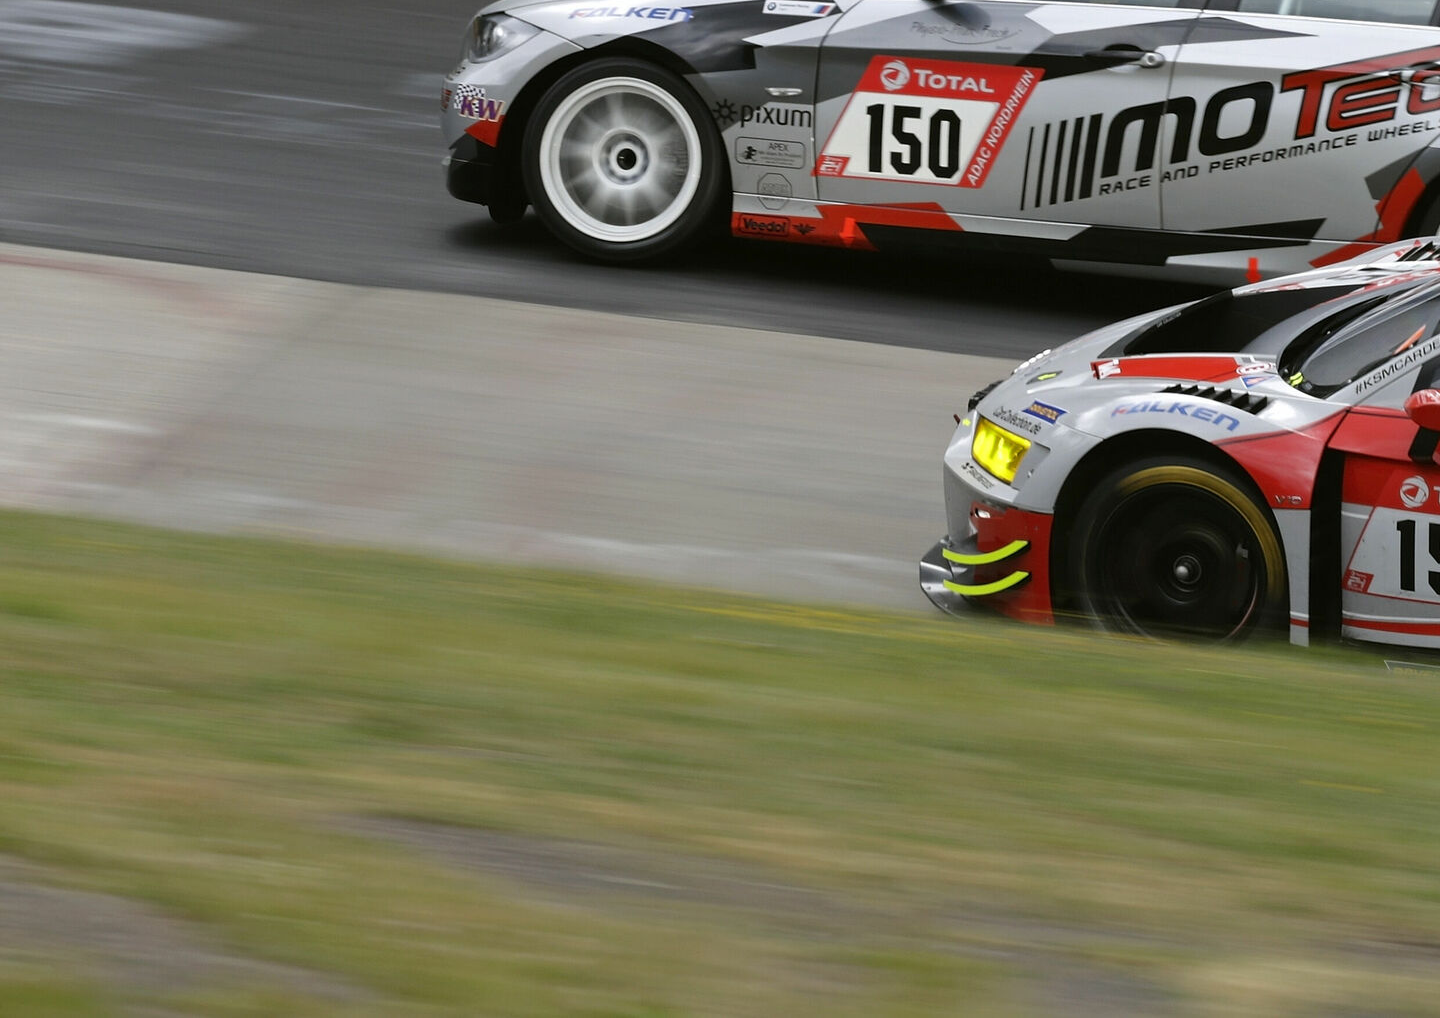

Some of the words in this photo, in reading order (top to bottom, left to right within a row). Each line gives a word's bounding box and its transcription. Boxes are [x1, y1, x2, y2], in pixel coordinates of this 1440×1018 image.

[568, 6, 693, 22] FALKEN
[913, 69, 995, 94] TOTAL
[460, 94, 505, 122] KW
[740, 104, 813, 128] pixum
[964, 146, 993, 186] ADAC
[984, 68, 1036, 149] NORDRHEIN
[768, 142, 789, 152] APEX
[866, 103, 961, 179] 150
[1099, 175, 1152, 195] RACE
[1160, 165, 1199, 183] AND
[1208, 134, 1358, 174] PERFORMANCE
[743, 218, 787, 232] Veedol
[1110, 401, 1241, 432] FALKEN
